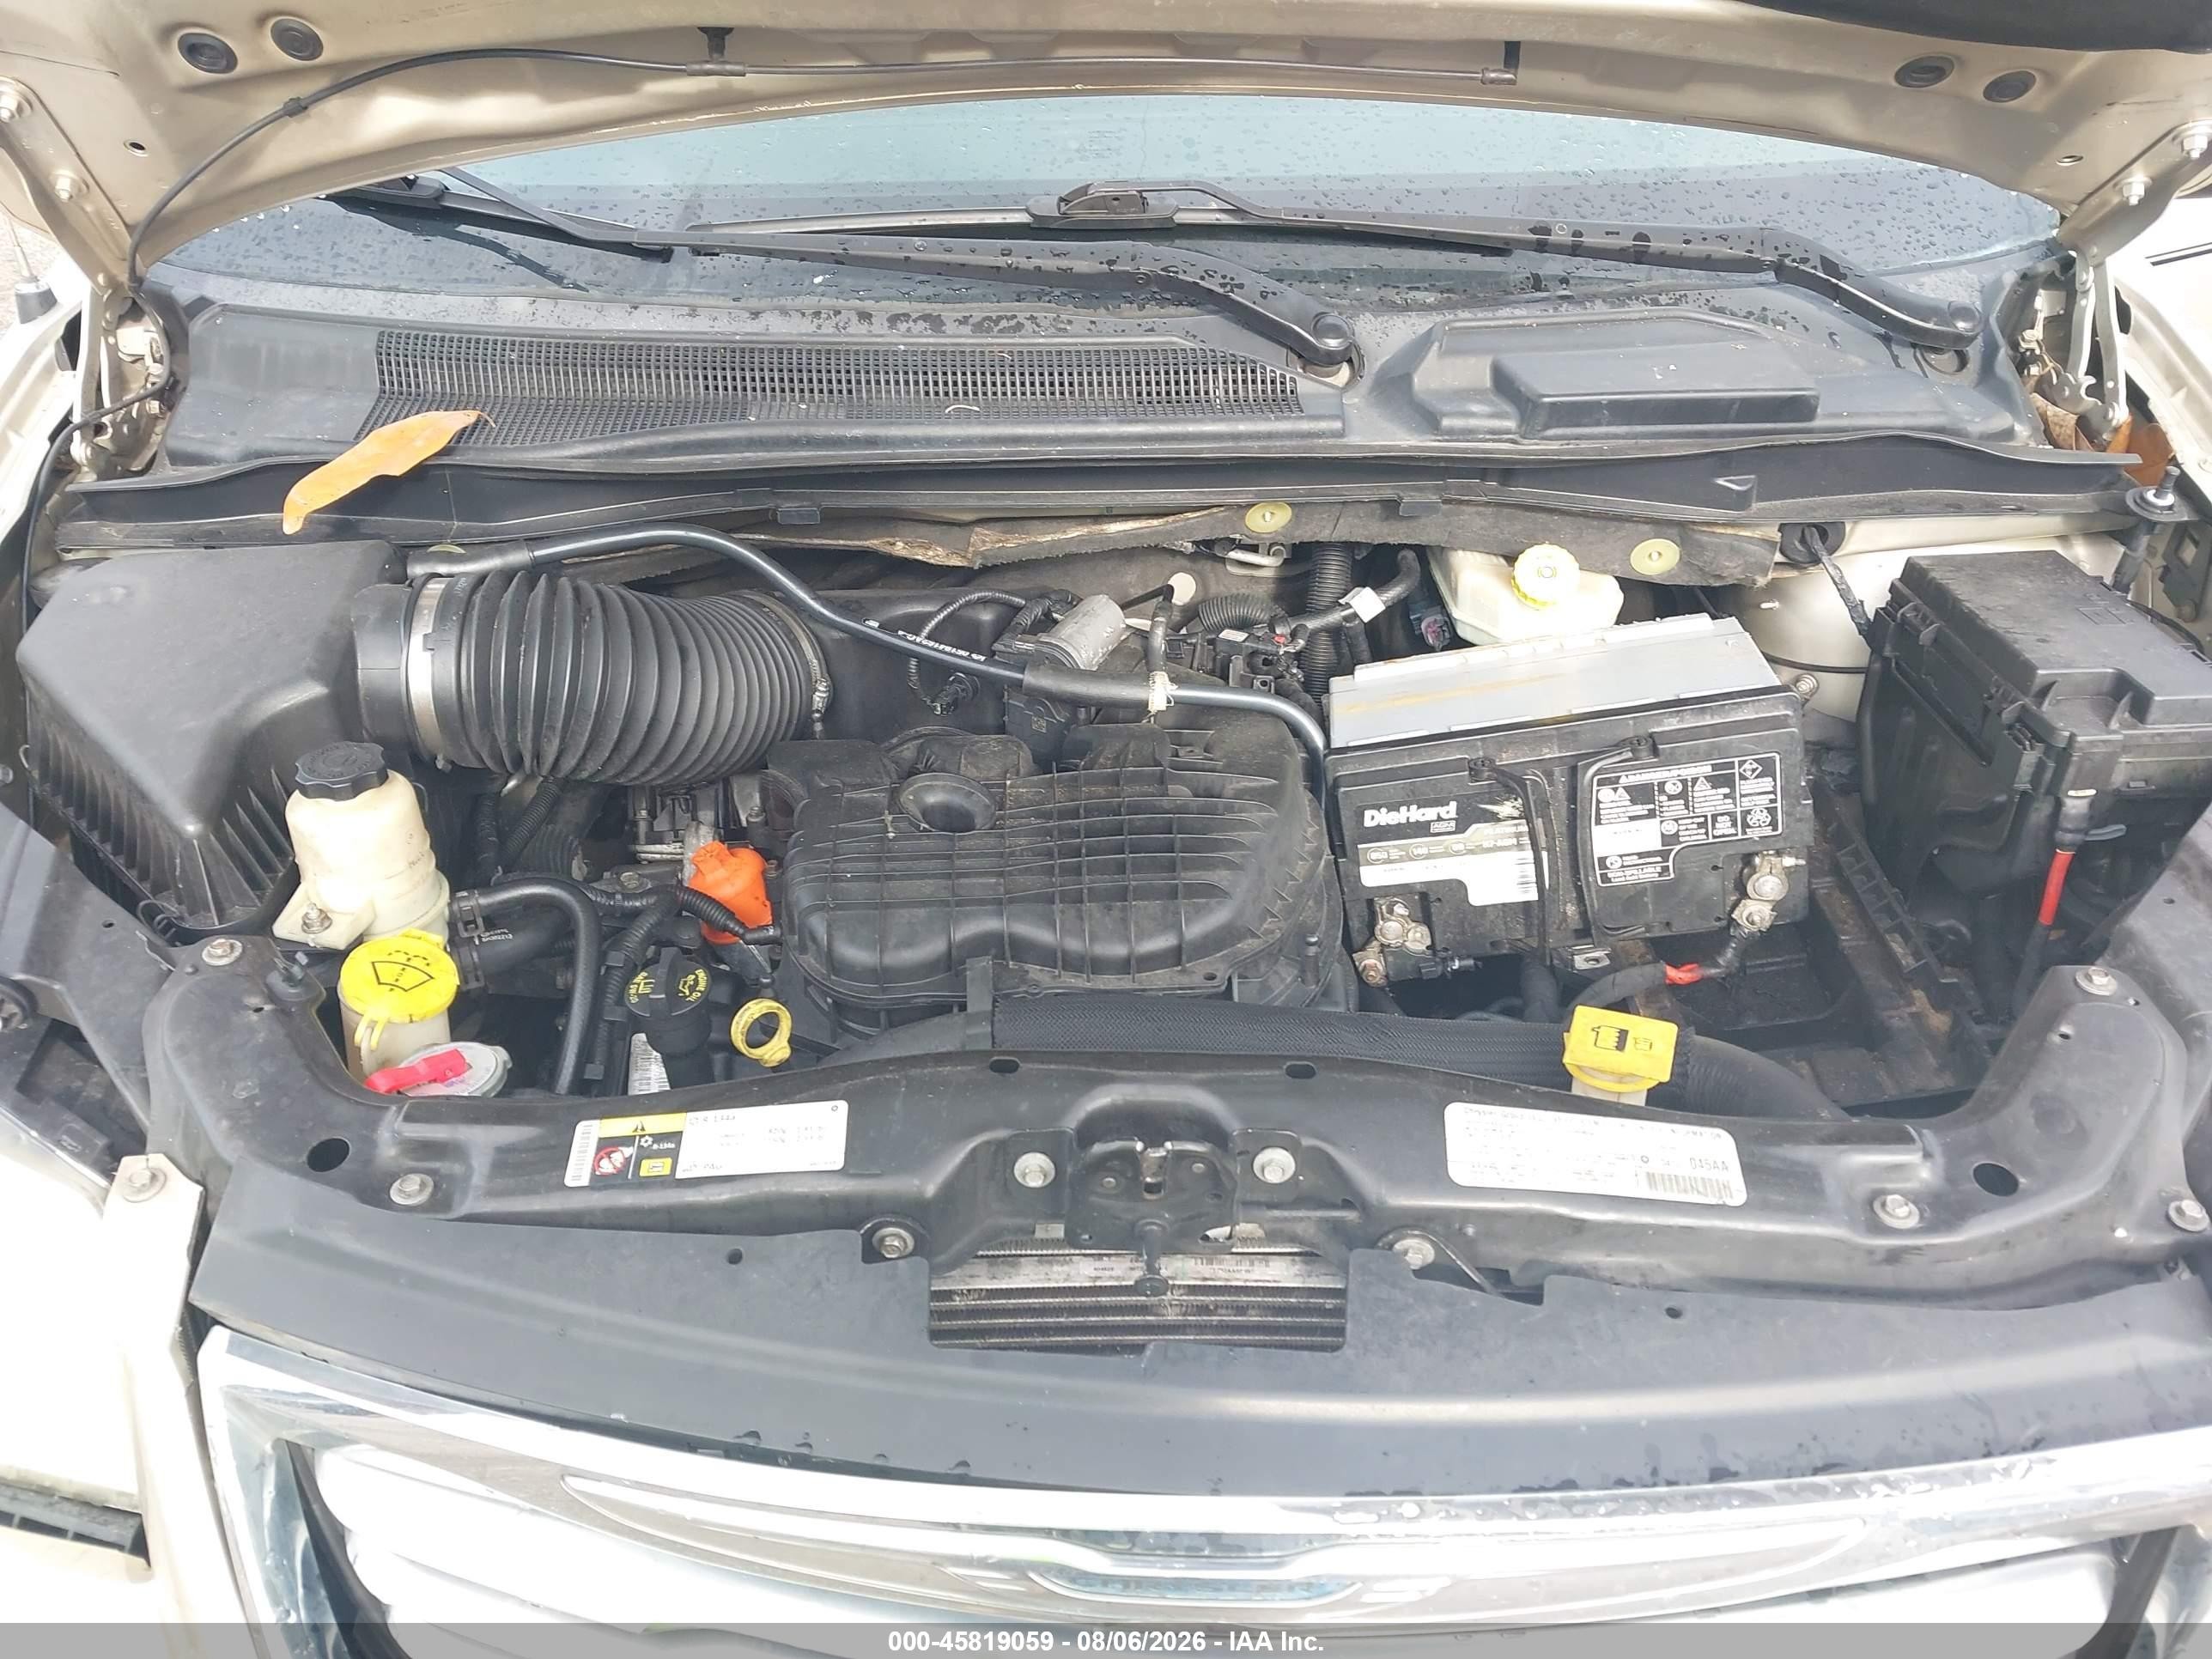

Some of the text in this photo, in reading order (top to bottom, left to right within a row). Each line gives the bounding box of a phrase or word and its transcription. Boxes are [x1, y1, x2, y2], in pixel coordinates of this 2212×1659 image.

[1364, 801, 1458, 828] DieHard
[685, 969, 708, 1002] ENGINE OIL
